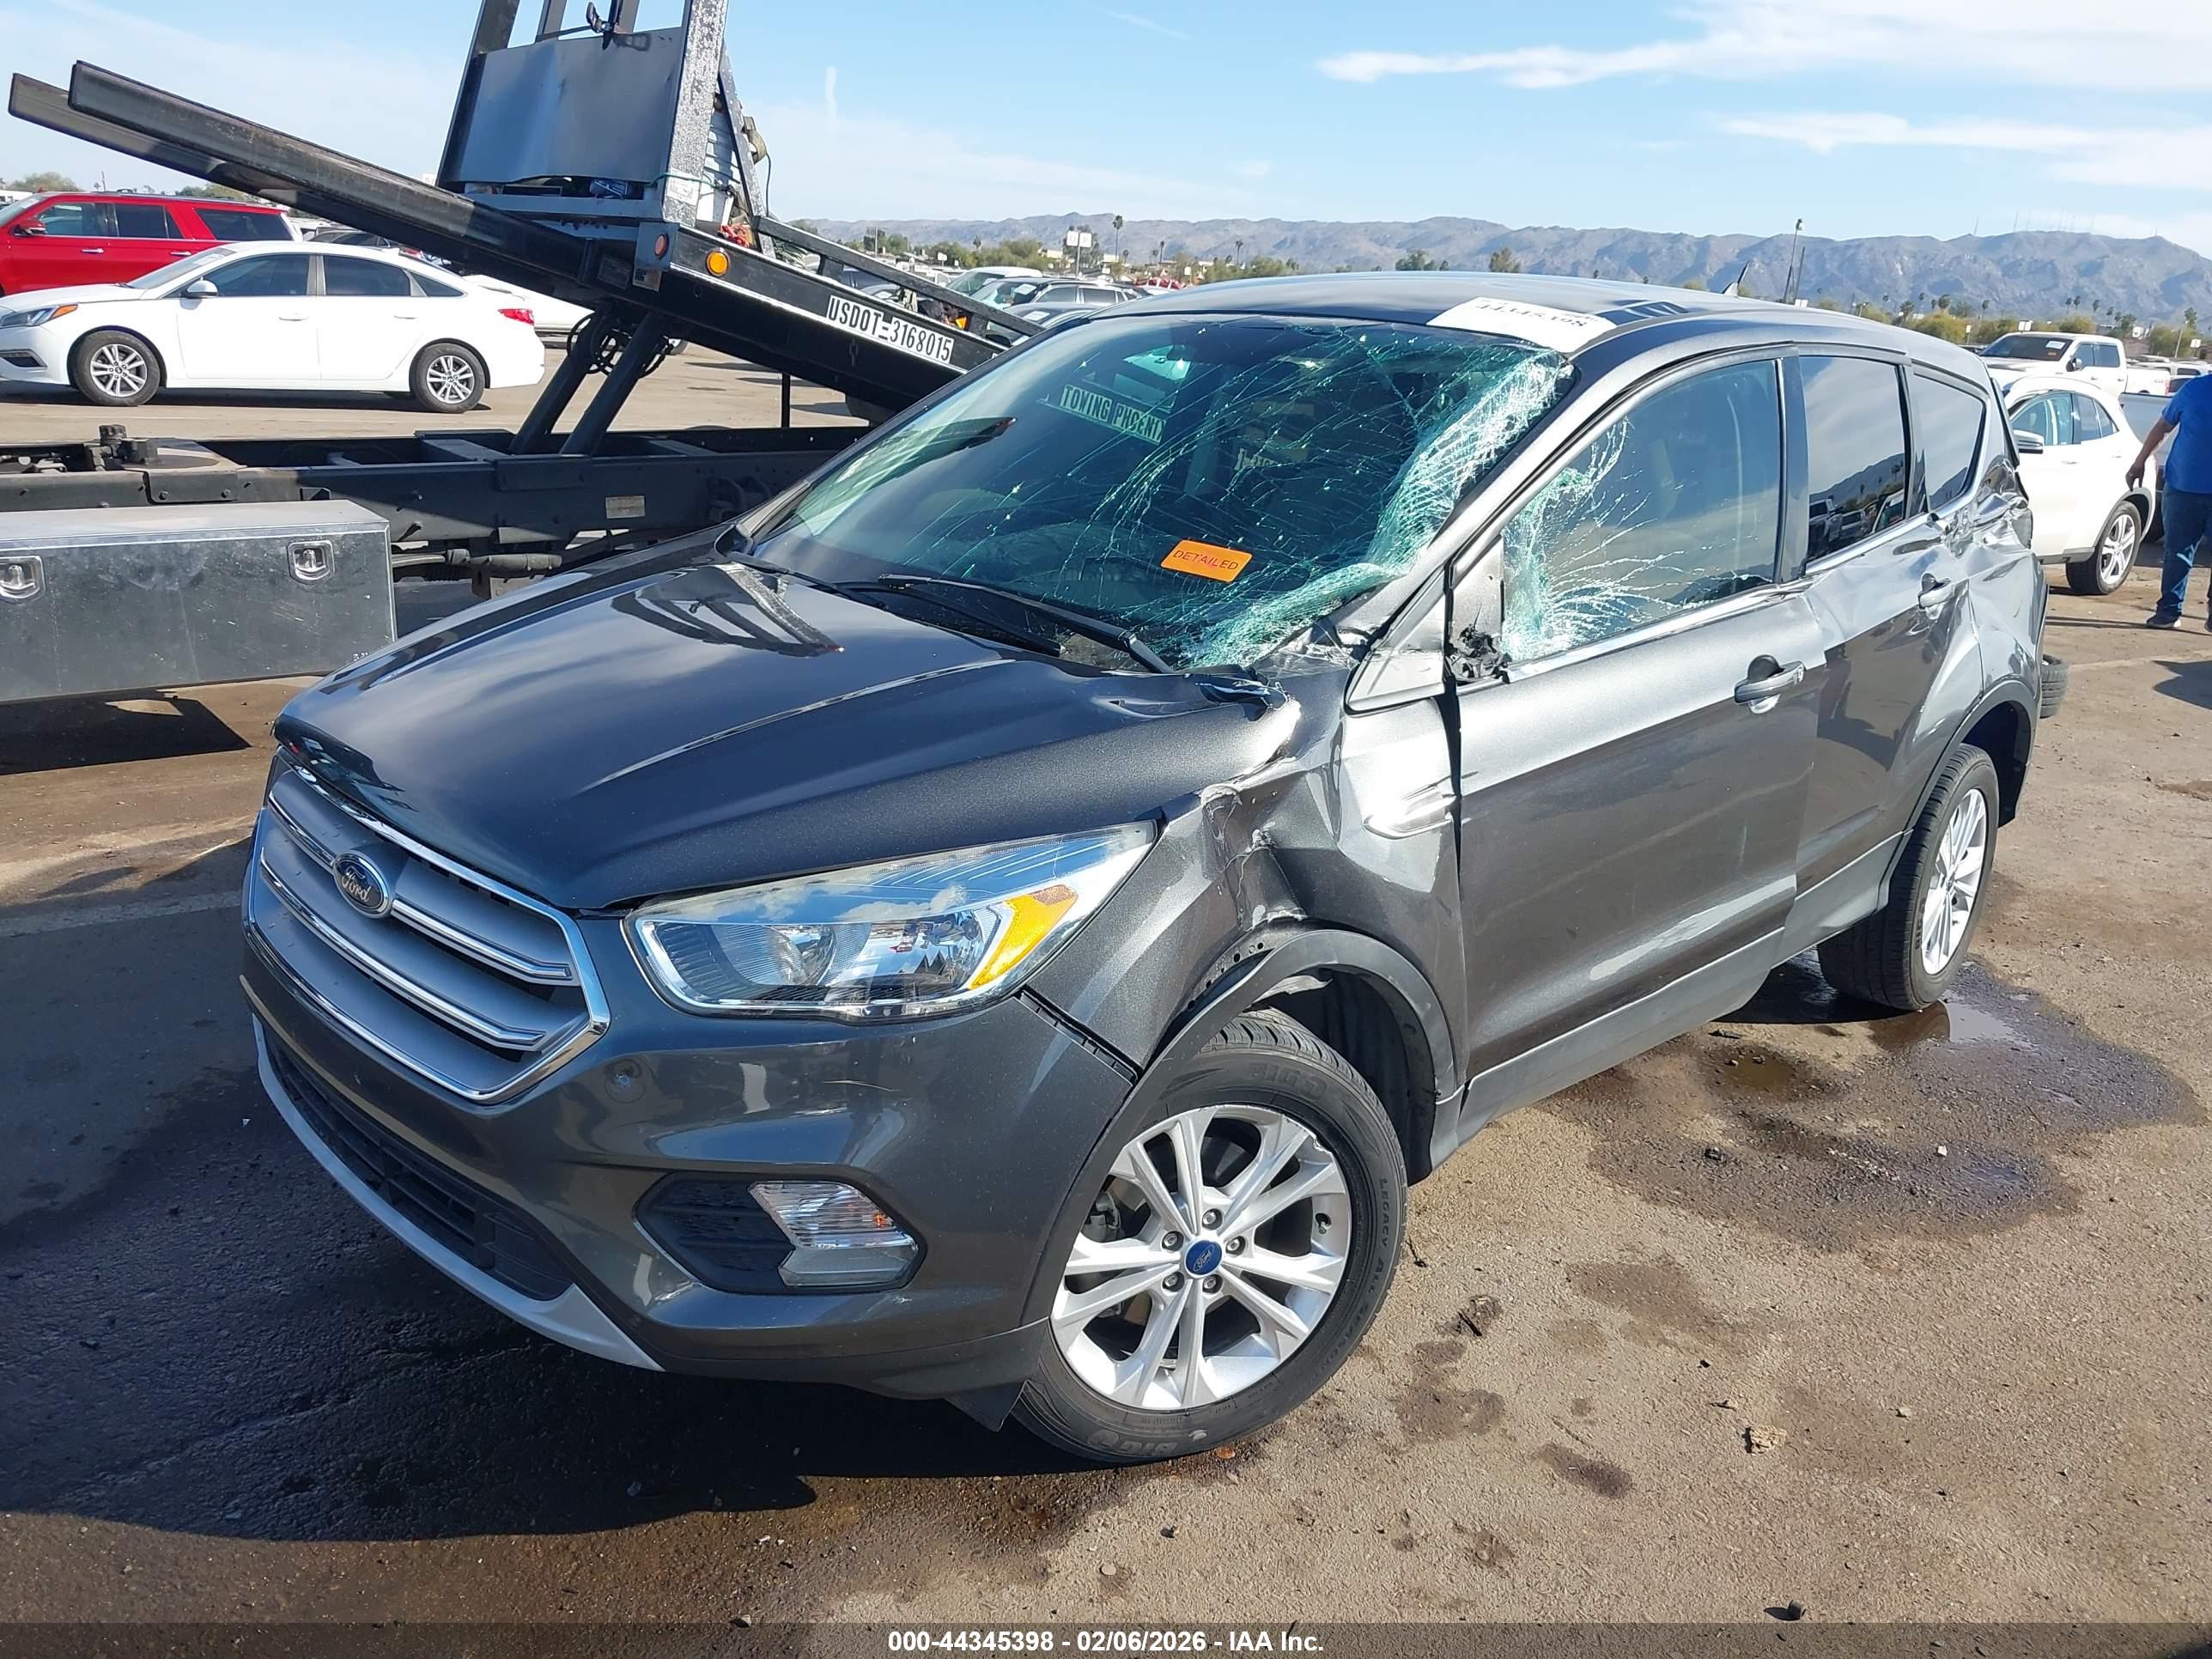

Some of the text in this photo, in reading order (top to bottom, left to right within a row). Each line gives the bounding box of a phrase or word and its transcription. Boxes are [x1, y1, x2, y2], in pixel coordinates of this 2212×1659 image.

[1062, 385, 1110, 421] TOWING
[1173, 550, 1238, 570] DETAILED
[342, 866, 373, 902] Ford
[1379, 1178, 1389, 1249] LEGACY
